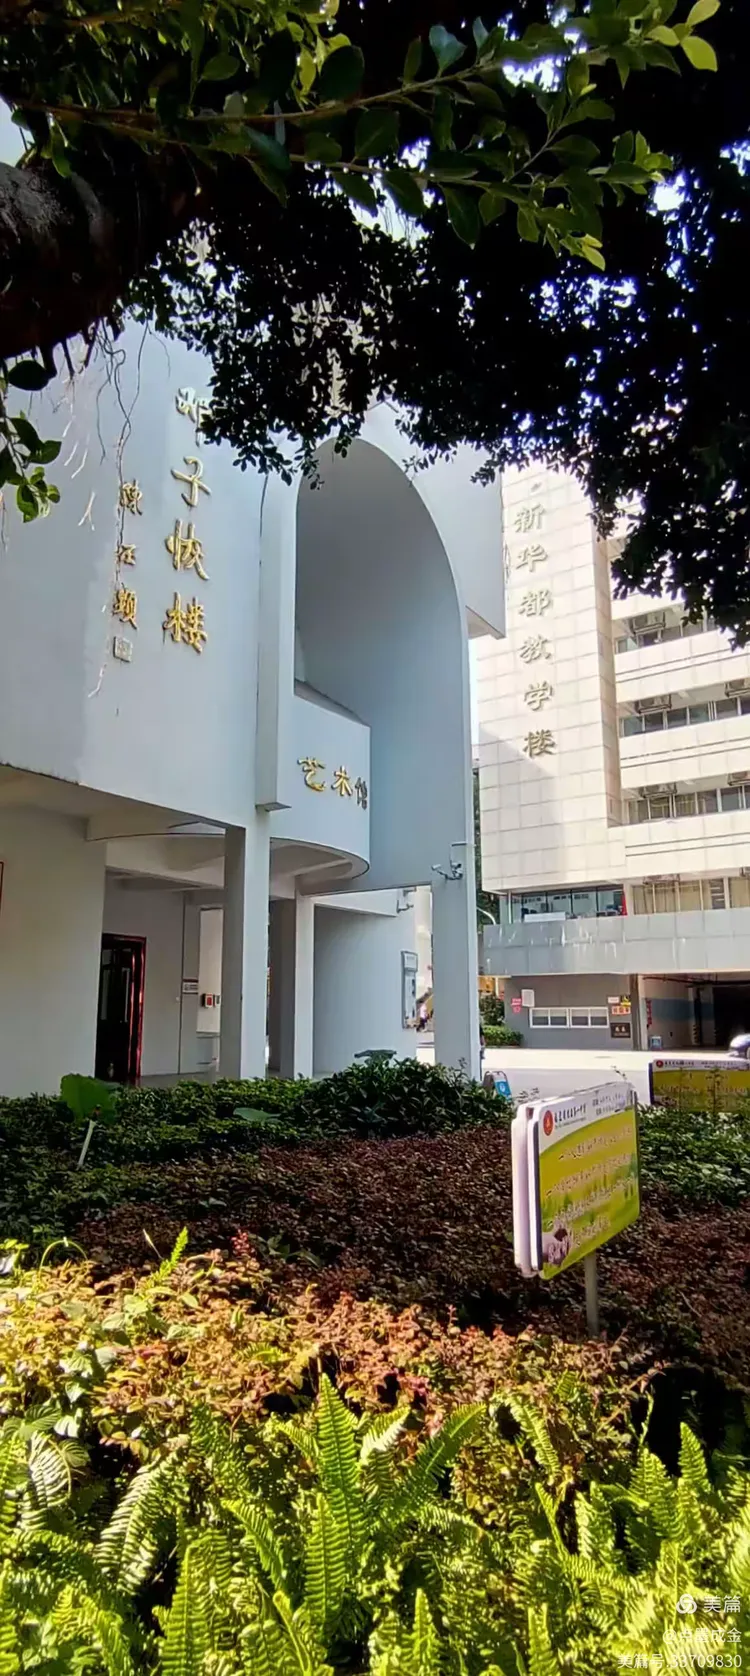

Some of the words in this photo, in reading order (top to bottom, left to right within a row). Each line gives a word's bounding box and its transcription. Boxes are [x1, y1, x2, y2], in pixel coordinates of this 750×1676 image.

[513, 502, 557, 758] 新华都教学楼
[297, 756, 368, 810] 艺术馆
